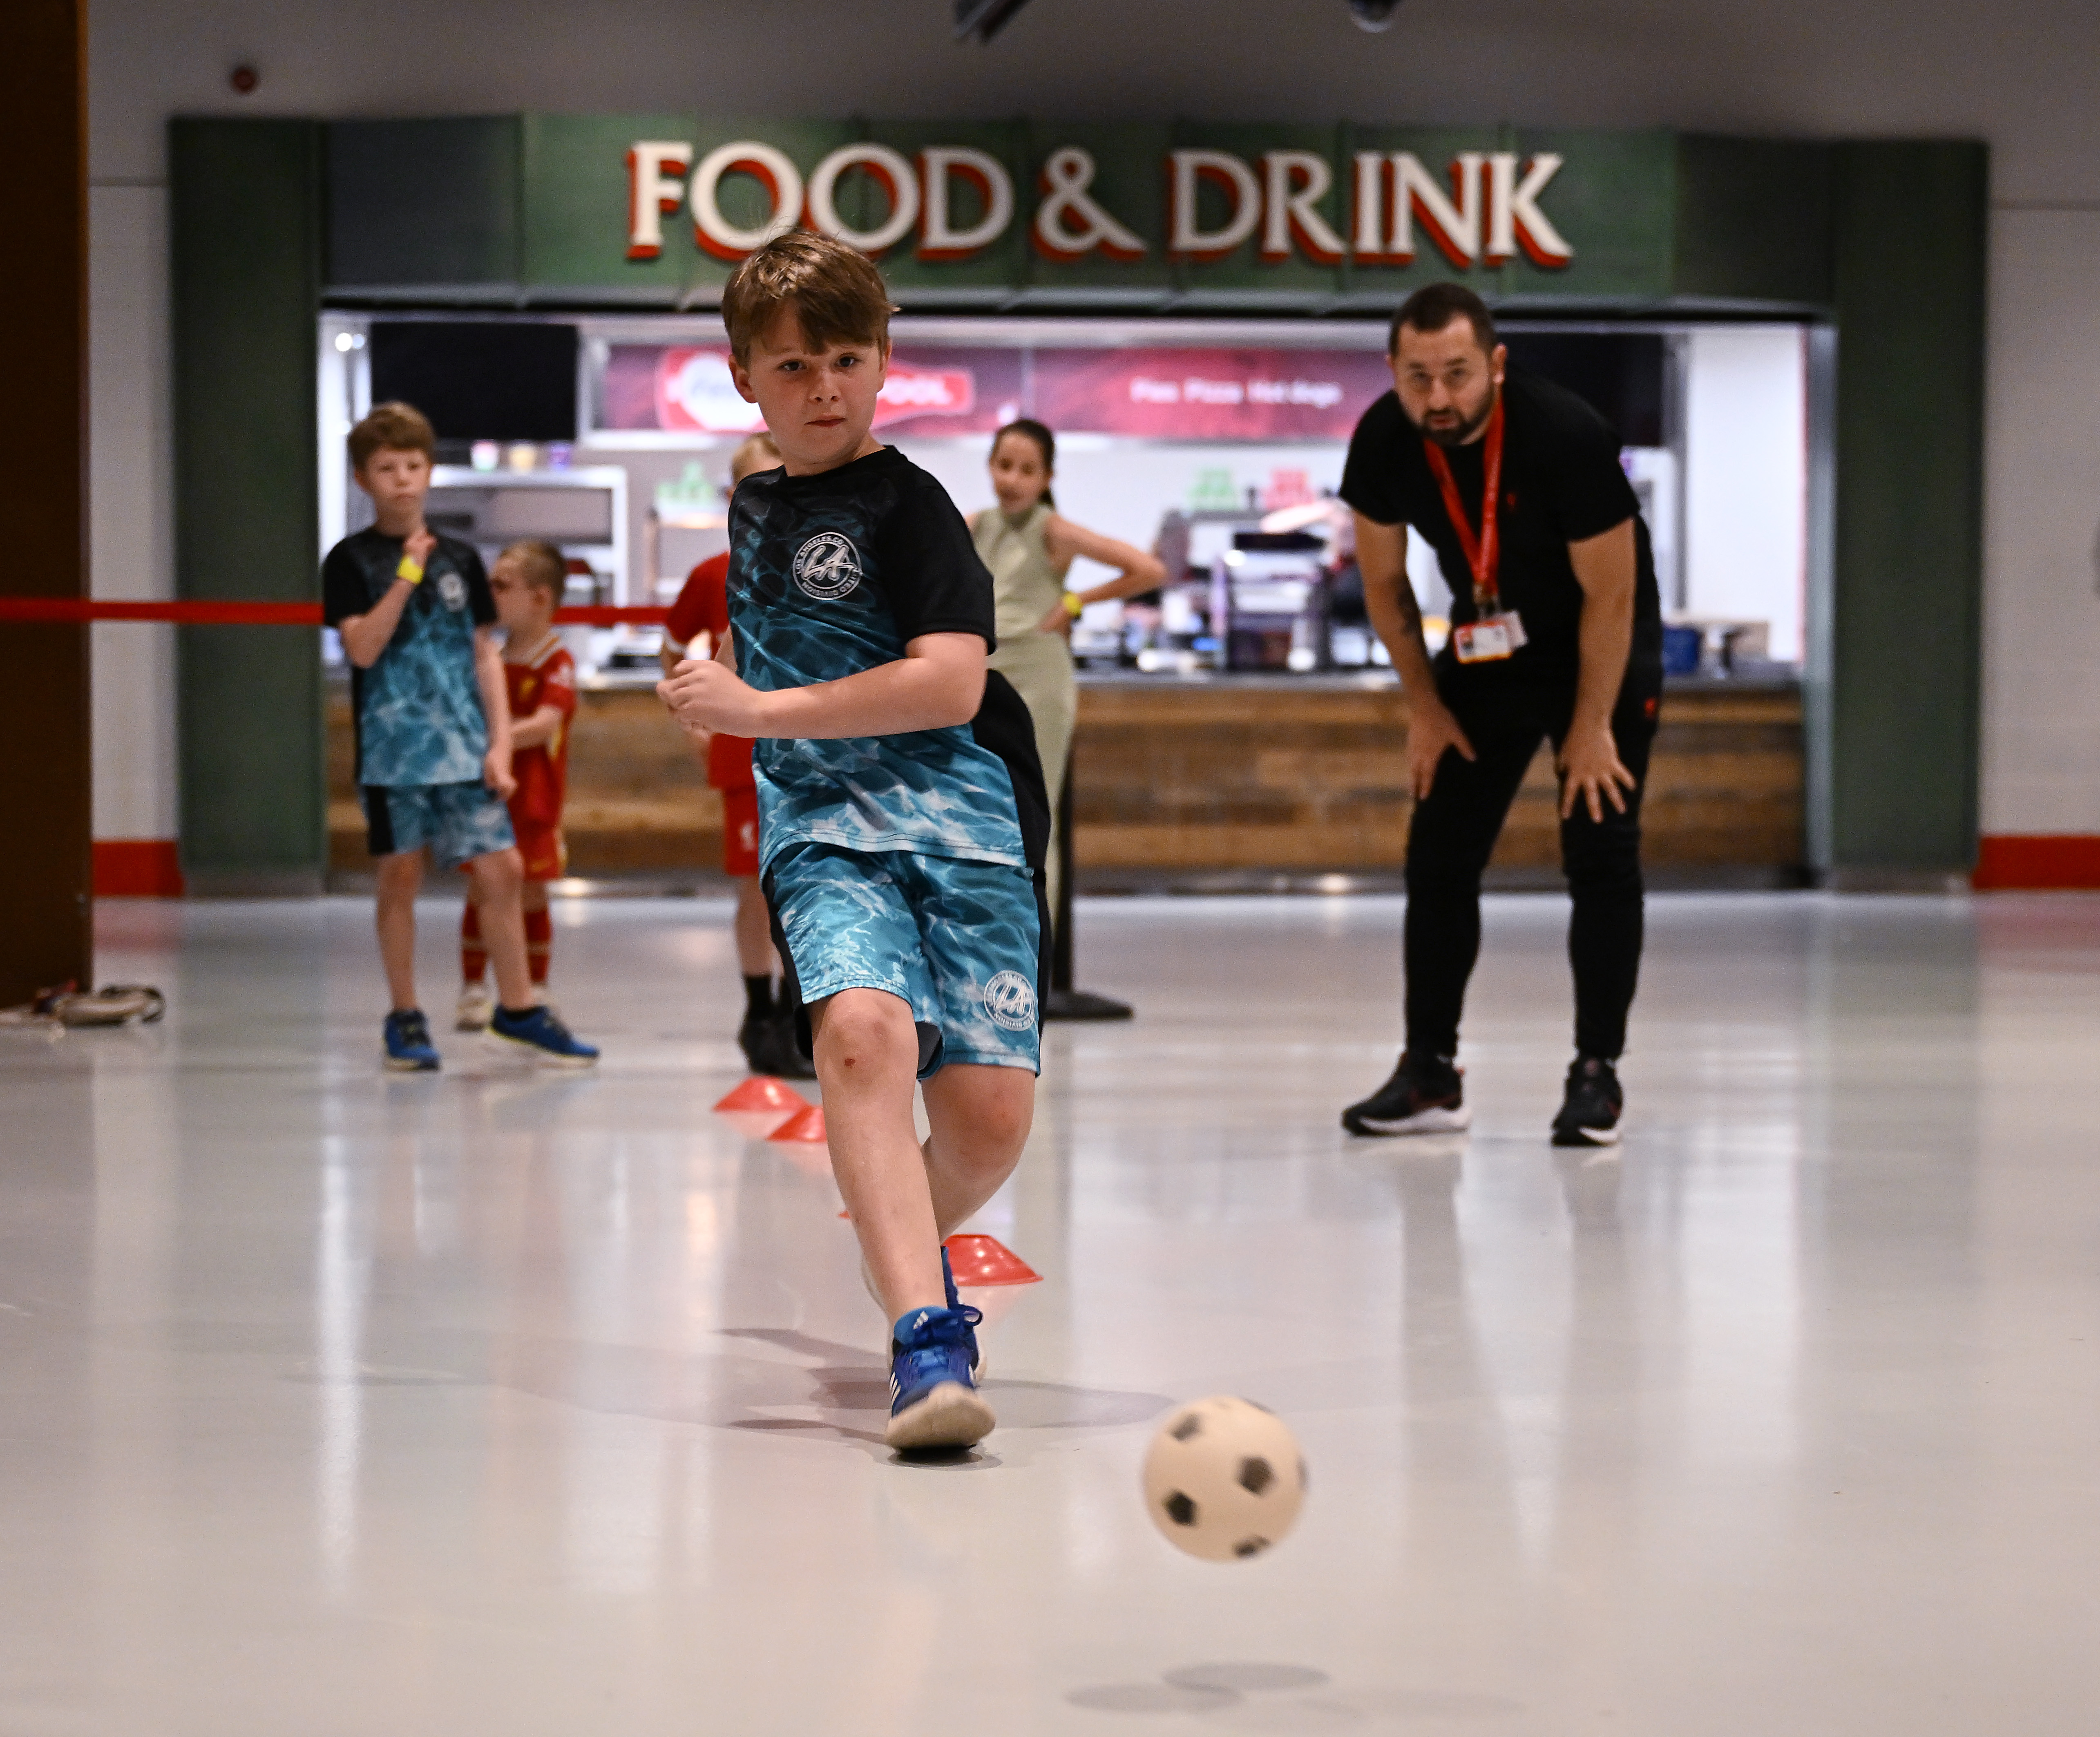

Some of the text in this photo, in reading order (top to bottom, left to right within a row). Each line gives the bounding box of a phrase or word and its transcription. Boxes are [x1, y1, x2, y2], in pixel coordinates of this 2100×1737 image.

[627, 140, 1573, 268] FOOD & DRINK
[800, 536, 832, 557] ANGELES
